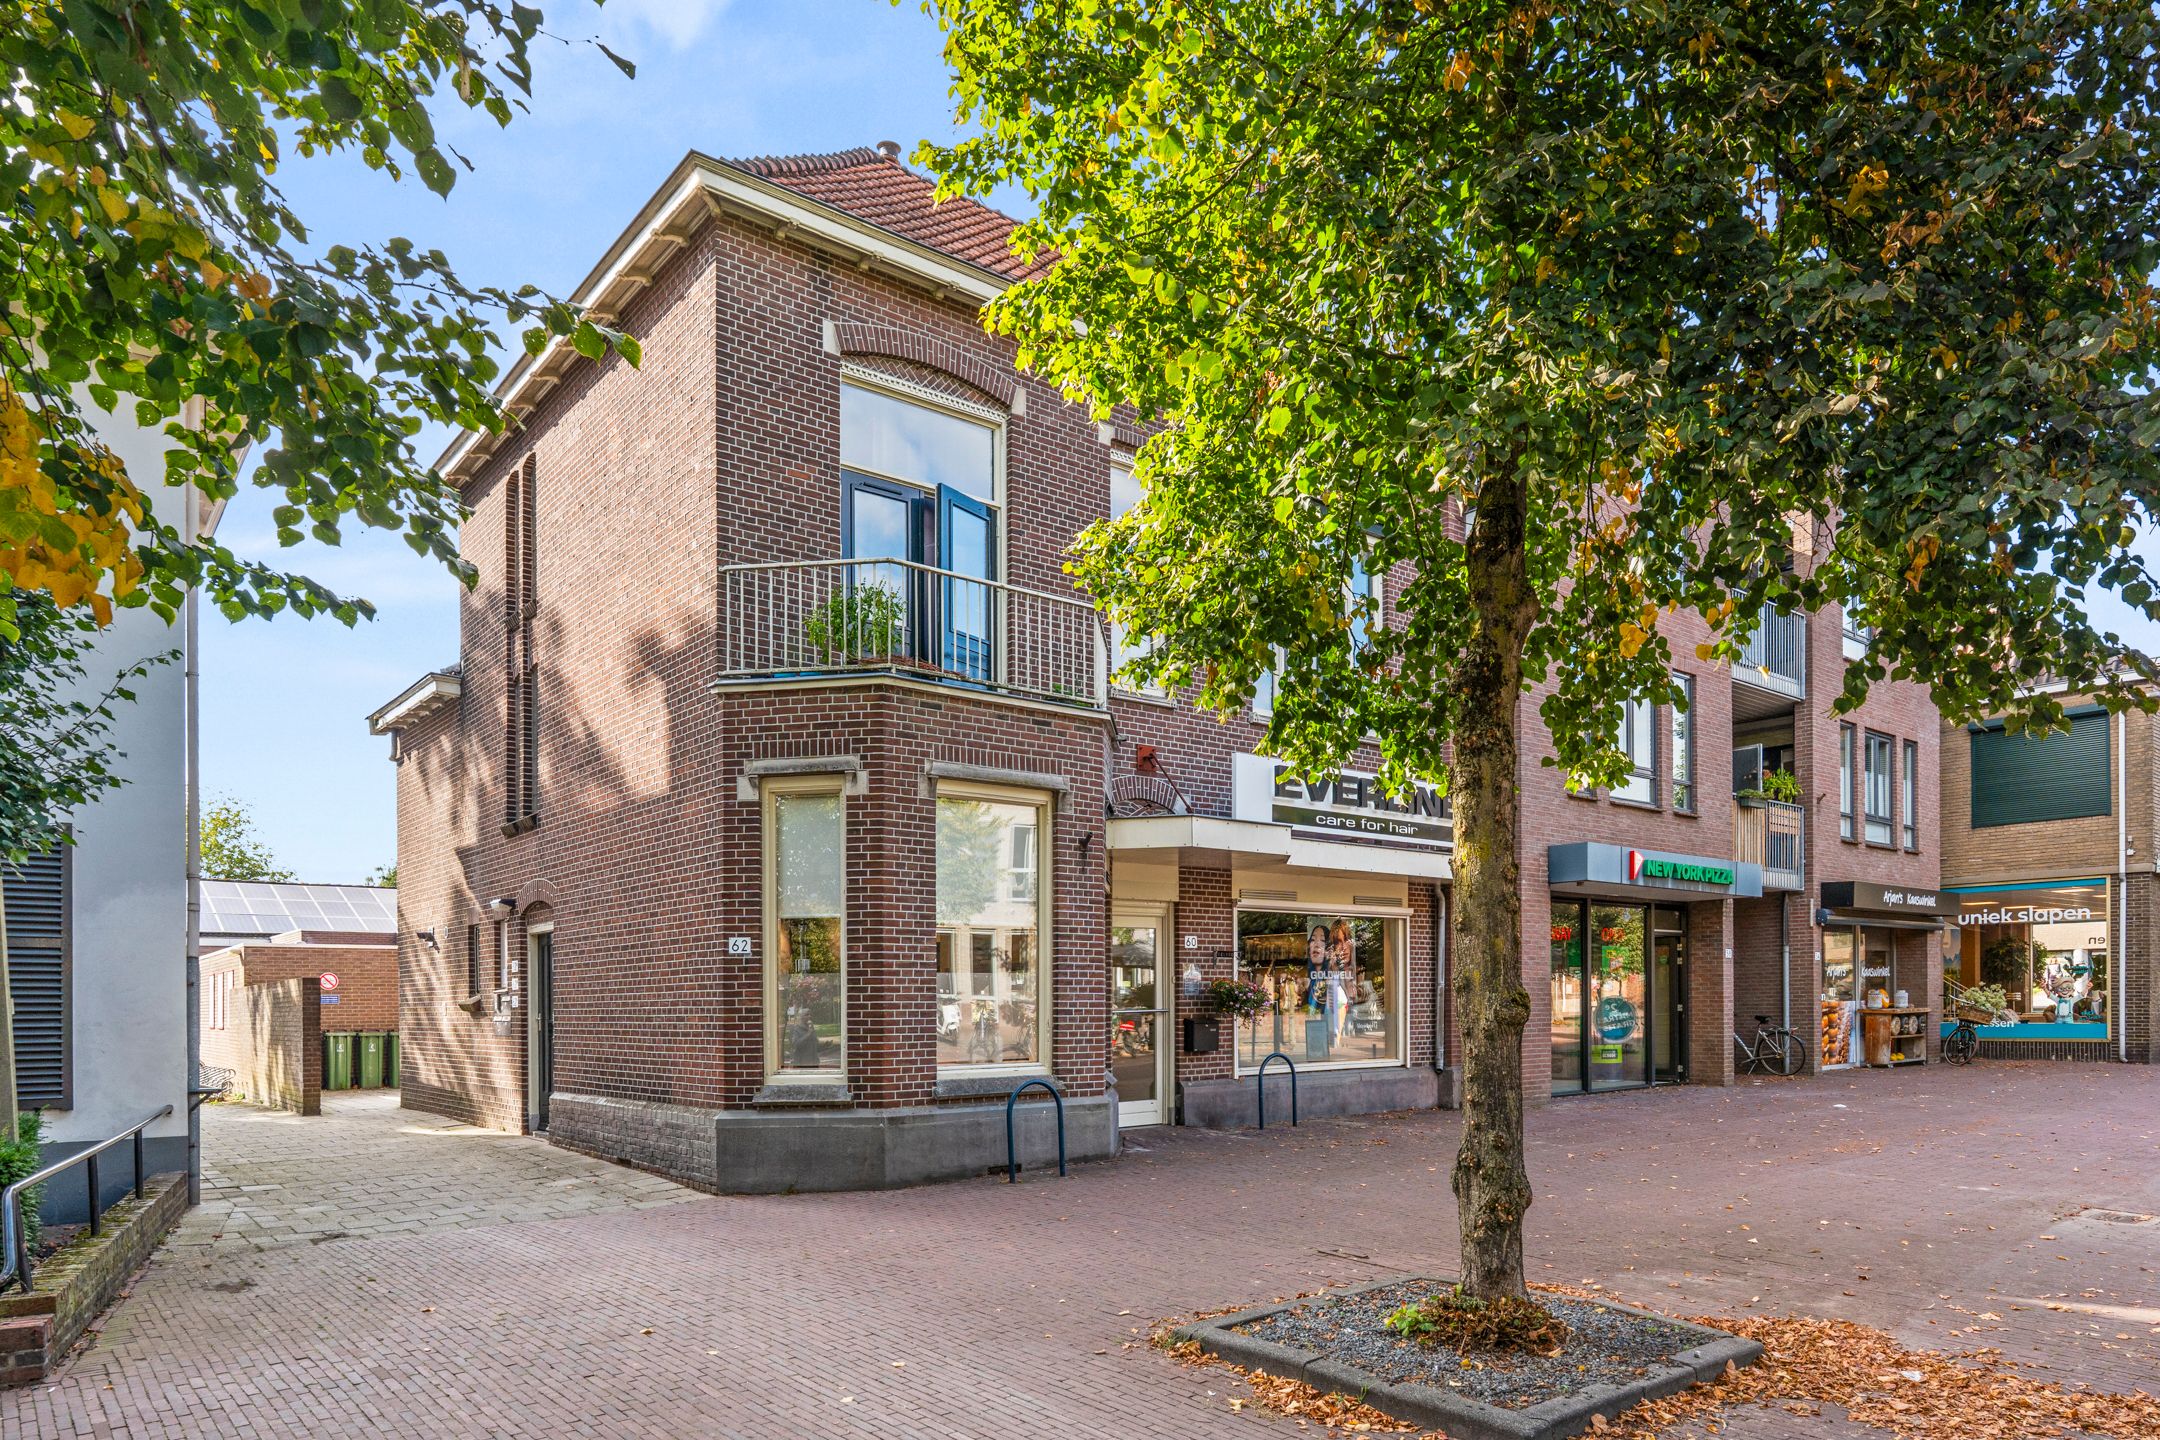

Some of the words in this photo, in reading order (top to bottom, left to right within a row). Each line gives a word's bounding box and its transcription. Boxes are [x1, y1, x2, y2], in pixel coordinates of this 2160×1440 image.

[1315, 814, 1356, 829] care
[1361, 818, 1385, 831] for
[1389, 821, 1419, 836] hair
[1645, 860, 1675, 879] NEW
[1676, 863, 1705, 882] YORK
[1705, 866, 1734, 885] PIZZA
[1958, 908, 2013, 926] uniek
[2017, 906, 2091, 925] slapen
[731, 939, 748, 952] 62
[1185, 937, 1197, 947] 60
[1310, 970, 1354, 980] GOLDWELL
